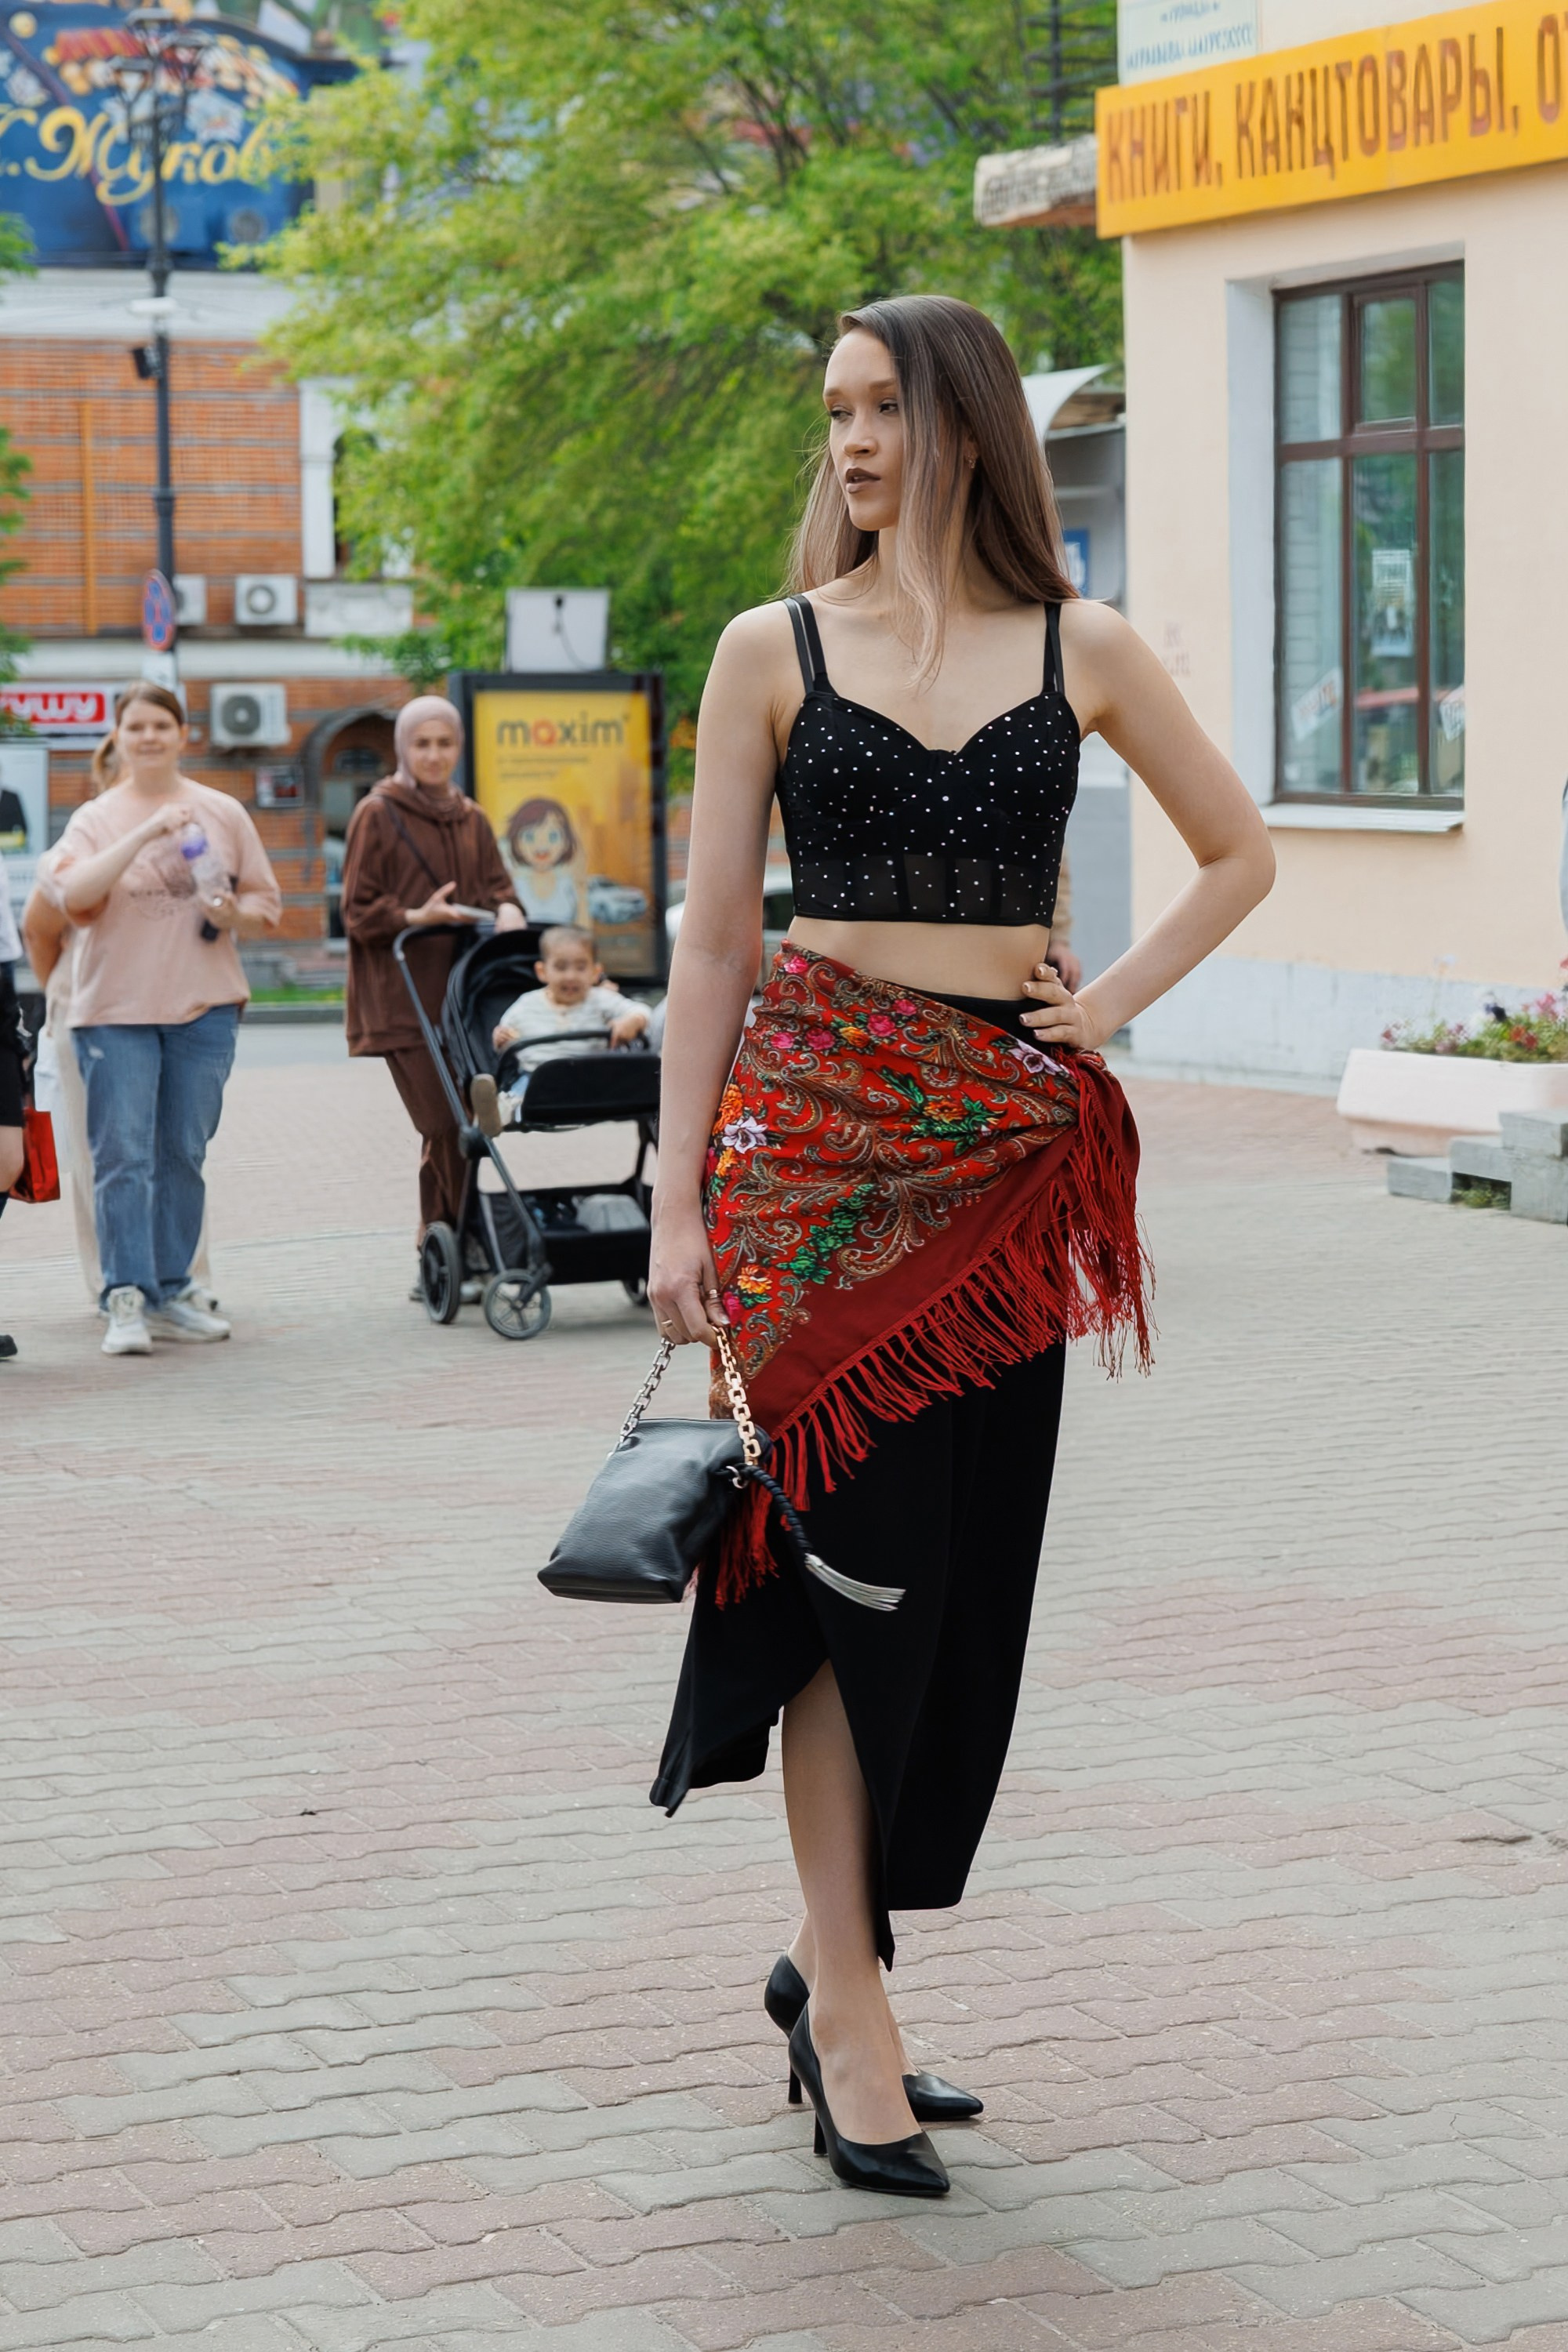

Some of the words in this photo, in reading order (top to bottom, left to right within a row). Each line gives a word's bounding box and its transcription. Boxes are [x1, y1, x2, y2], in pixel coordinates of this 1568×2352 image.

[1106, 91, 1222, 205] КНИГИ,
[1235, 27, 1519, 181] КАНЦТОВАРЫ,
[1537, 11, 1568, 125] О
